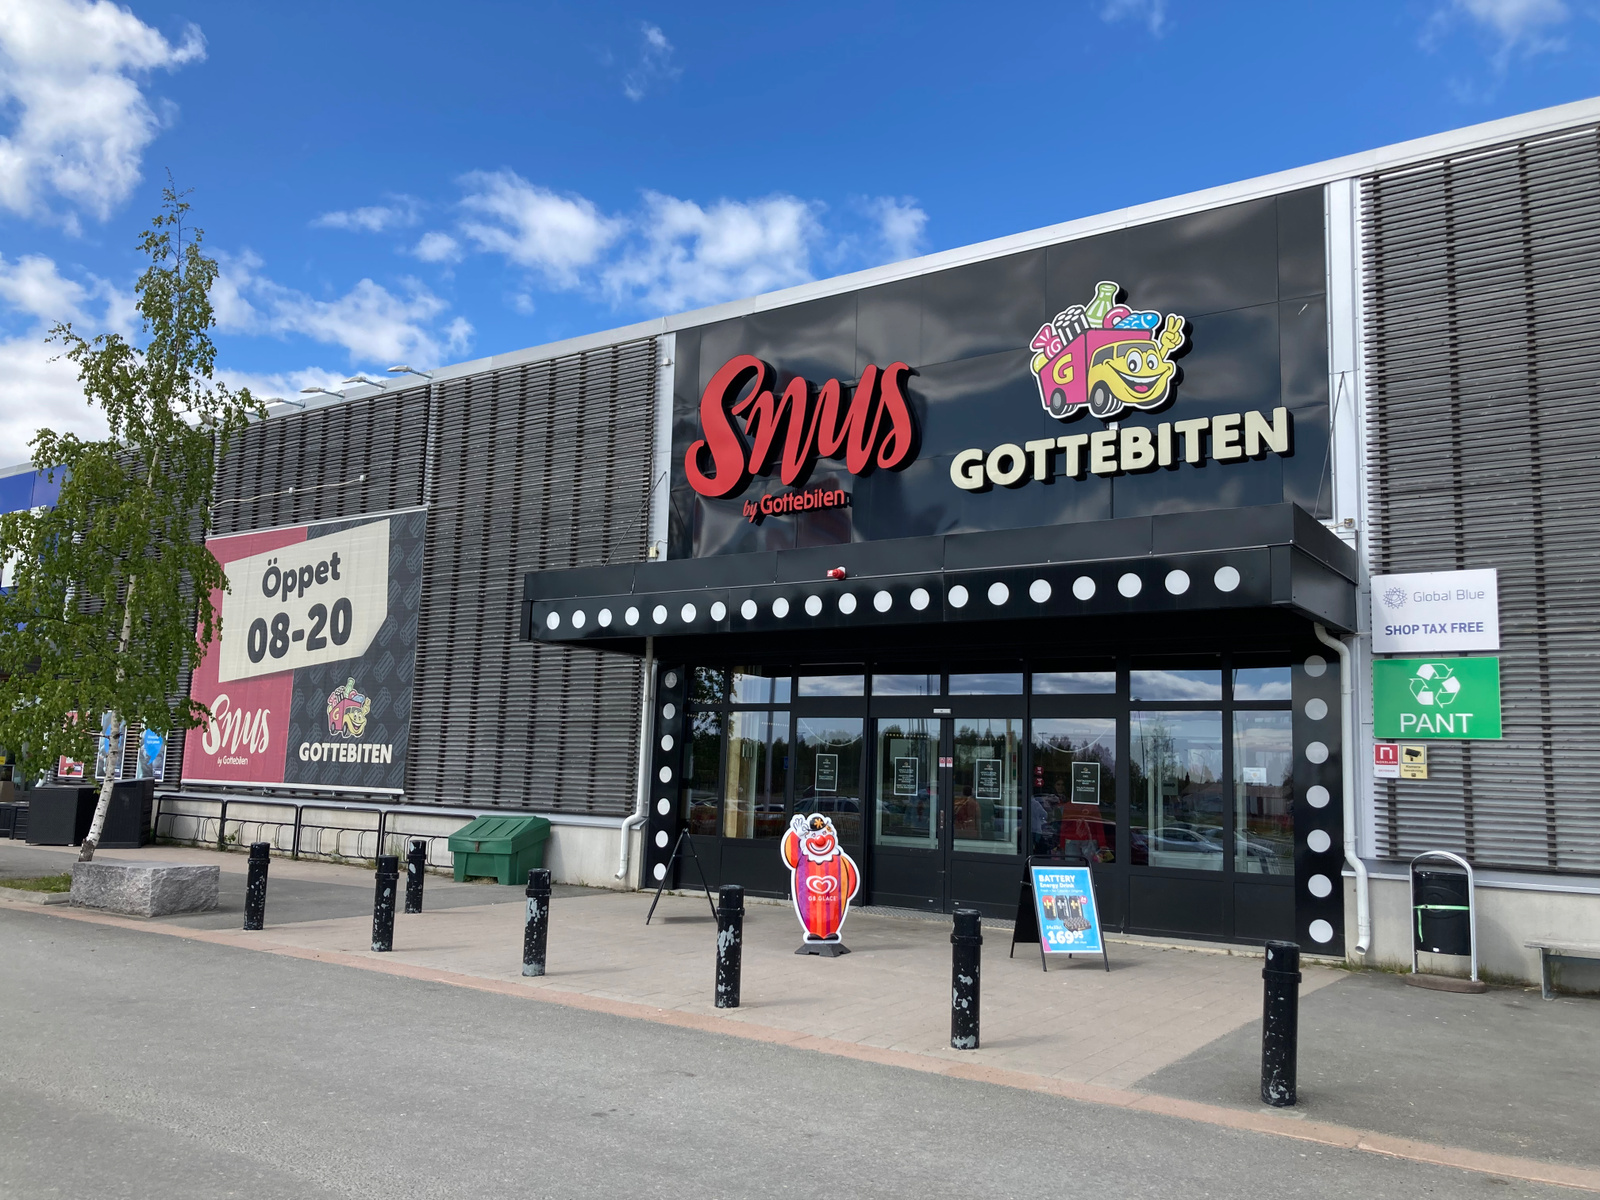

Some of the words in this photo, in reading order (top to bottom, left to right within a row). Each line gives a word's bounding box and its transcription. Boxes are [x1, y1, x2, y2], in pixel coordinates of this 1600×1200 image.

[685, 354, 913, 497] Snus
[950, 406, 1289, 490] GOTTEBITEN
[743, 499, 758, 523] by
[760, 488, 845, 514] Gottebiten
[262, 552, 341, 602] Öppet
[1413, 589, 1451, 603] Global
[1456, 589, 1485, 600] Blue
[247, 597, 353, 664] 08-20
[1385, 624, 1420, 636] SHOP
[1423, 623, 1448, 635] TAX
[1450, 622, 1484, 633] FREE
[202, 694, 271, 755] Snus
[1400, 713, 1474, 734] PANT
[222, 755, 249, 765] Gottebiten
[299, 742, 393, 764] GOTTEBITEN
[1038, 874, 1075, 883] BATTERY
